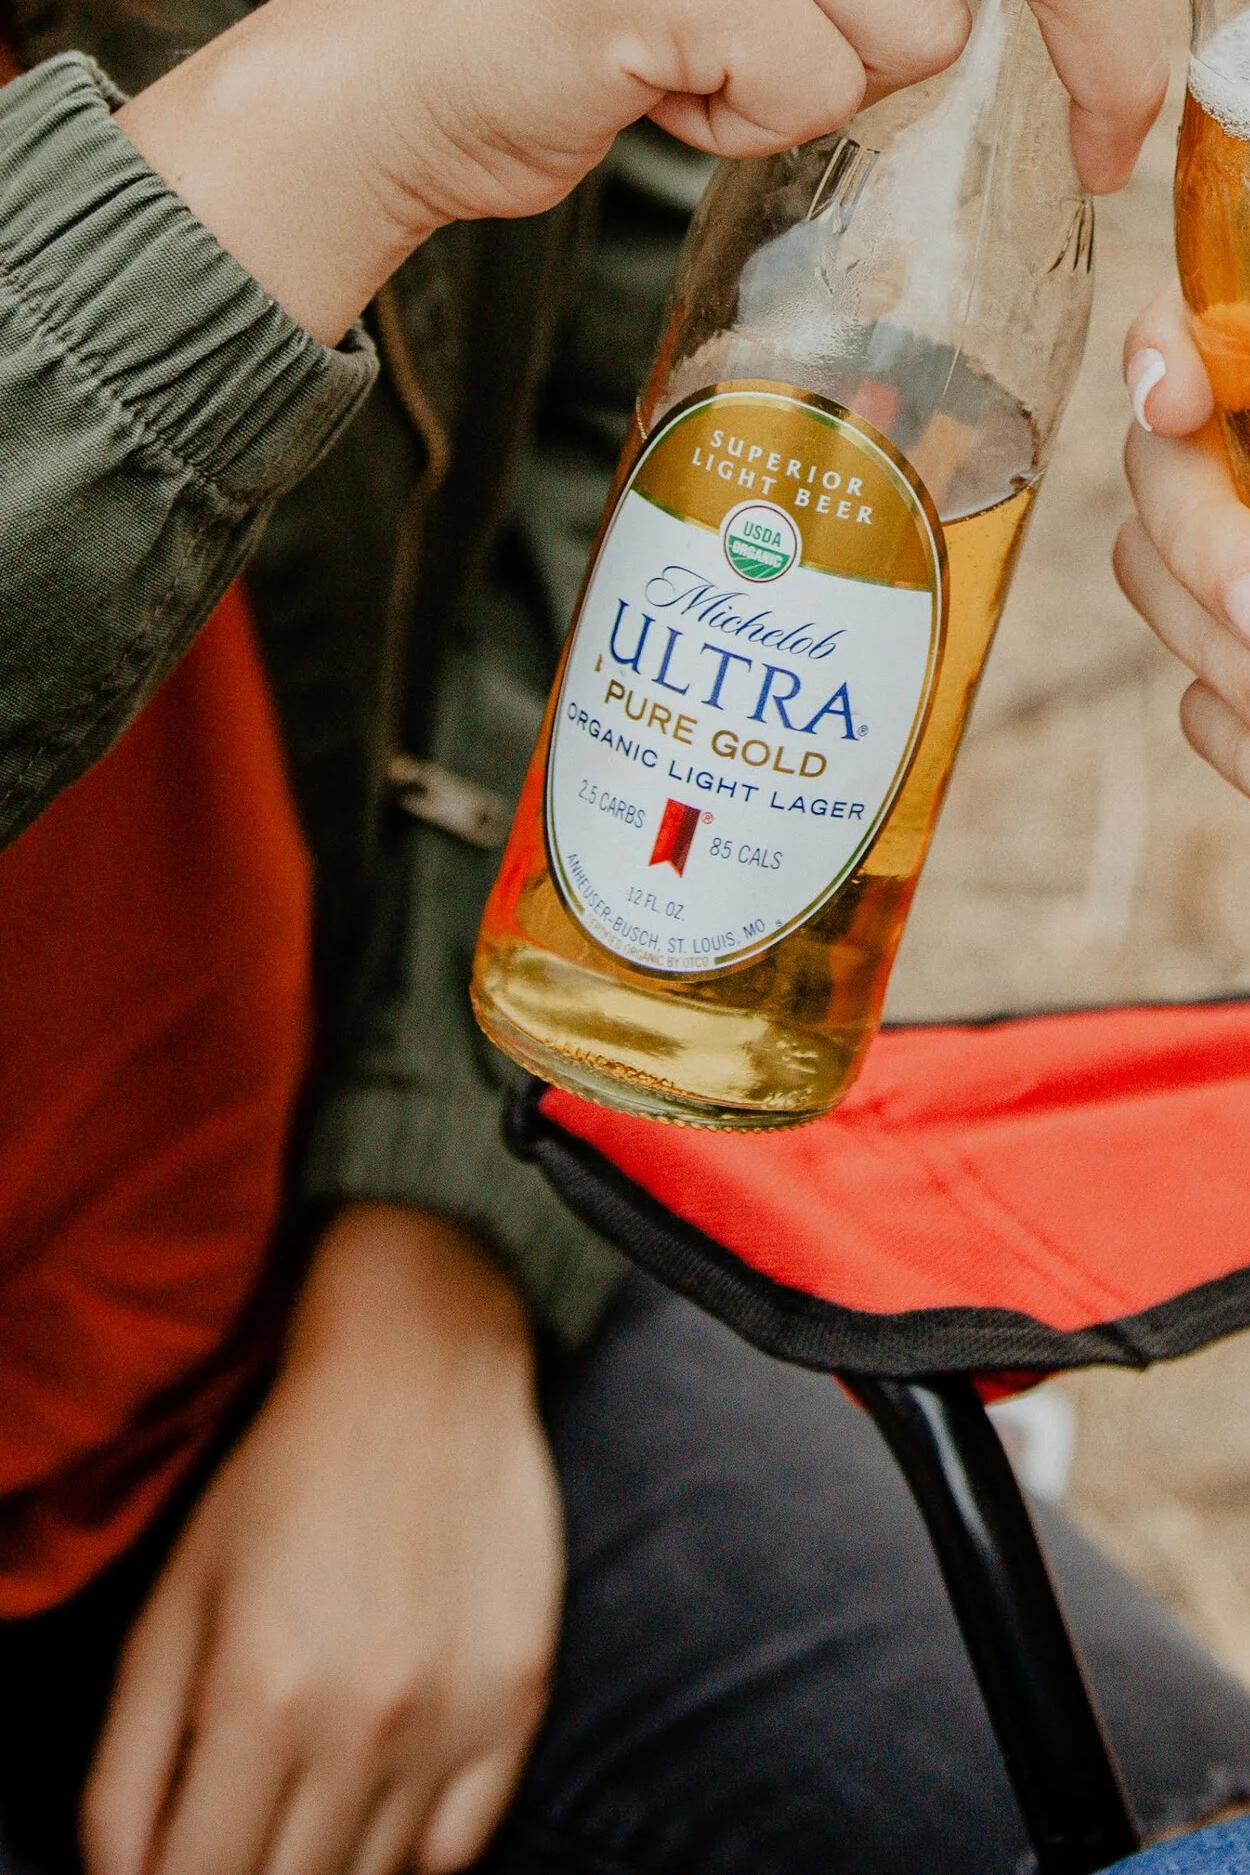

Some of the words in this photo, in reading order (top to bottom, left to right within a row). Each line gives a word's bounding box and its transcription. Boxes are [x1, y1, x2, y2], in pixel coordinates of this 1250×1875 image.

[691, 447, 777, 496] LIGHT
[793, 487, 873, 525] BEER
[710, 428, 863, 497] SUPERIOR
[730, 540, 783, 569] ORGANIC
[743, 520, 782, 548] USDA
[645, 565, 847, 660] Michelob
[608, 597, 862, 742] ULTRA
[604, 679, 699, 746] PURE
[710, 729, 828, 779] GOLD
[566, 701, 659, 768] ORGANIC
[668, 760, 760, 803] LIGHT
[770, 791, 866, 822] LAGER
[599, 791, 647, 829] CARBS
[709, 836, 733, 860] 85
[737, 844, 783, 871] CALS
[626, 886, 642, 905] 12
[743, 918, 766, 941] MO
